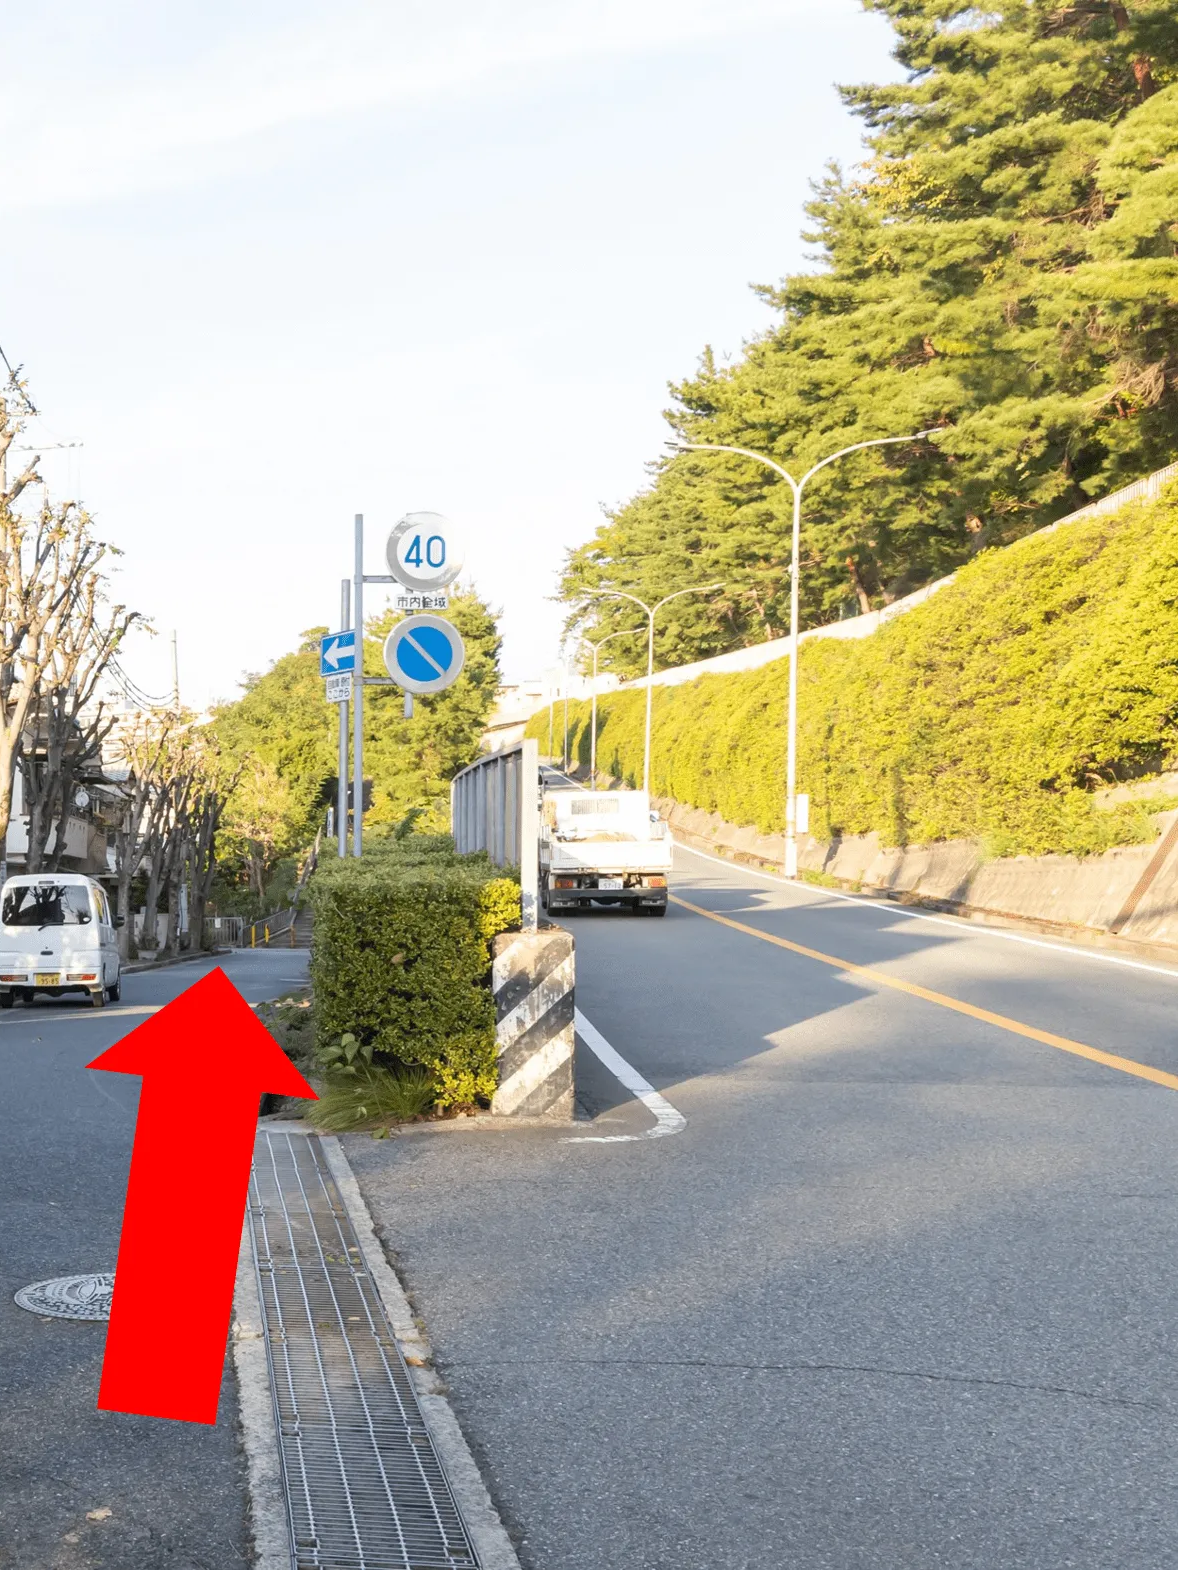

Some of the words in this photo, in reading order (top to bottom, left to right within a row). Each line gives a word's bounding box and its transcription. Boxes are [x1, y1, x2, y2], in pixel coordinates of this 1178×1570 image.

[404, 535, 446, 568] 40
[397, 596, 446, 608] 市内全域
[327, 687, 351, 700] ここから
